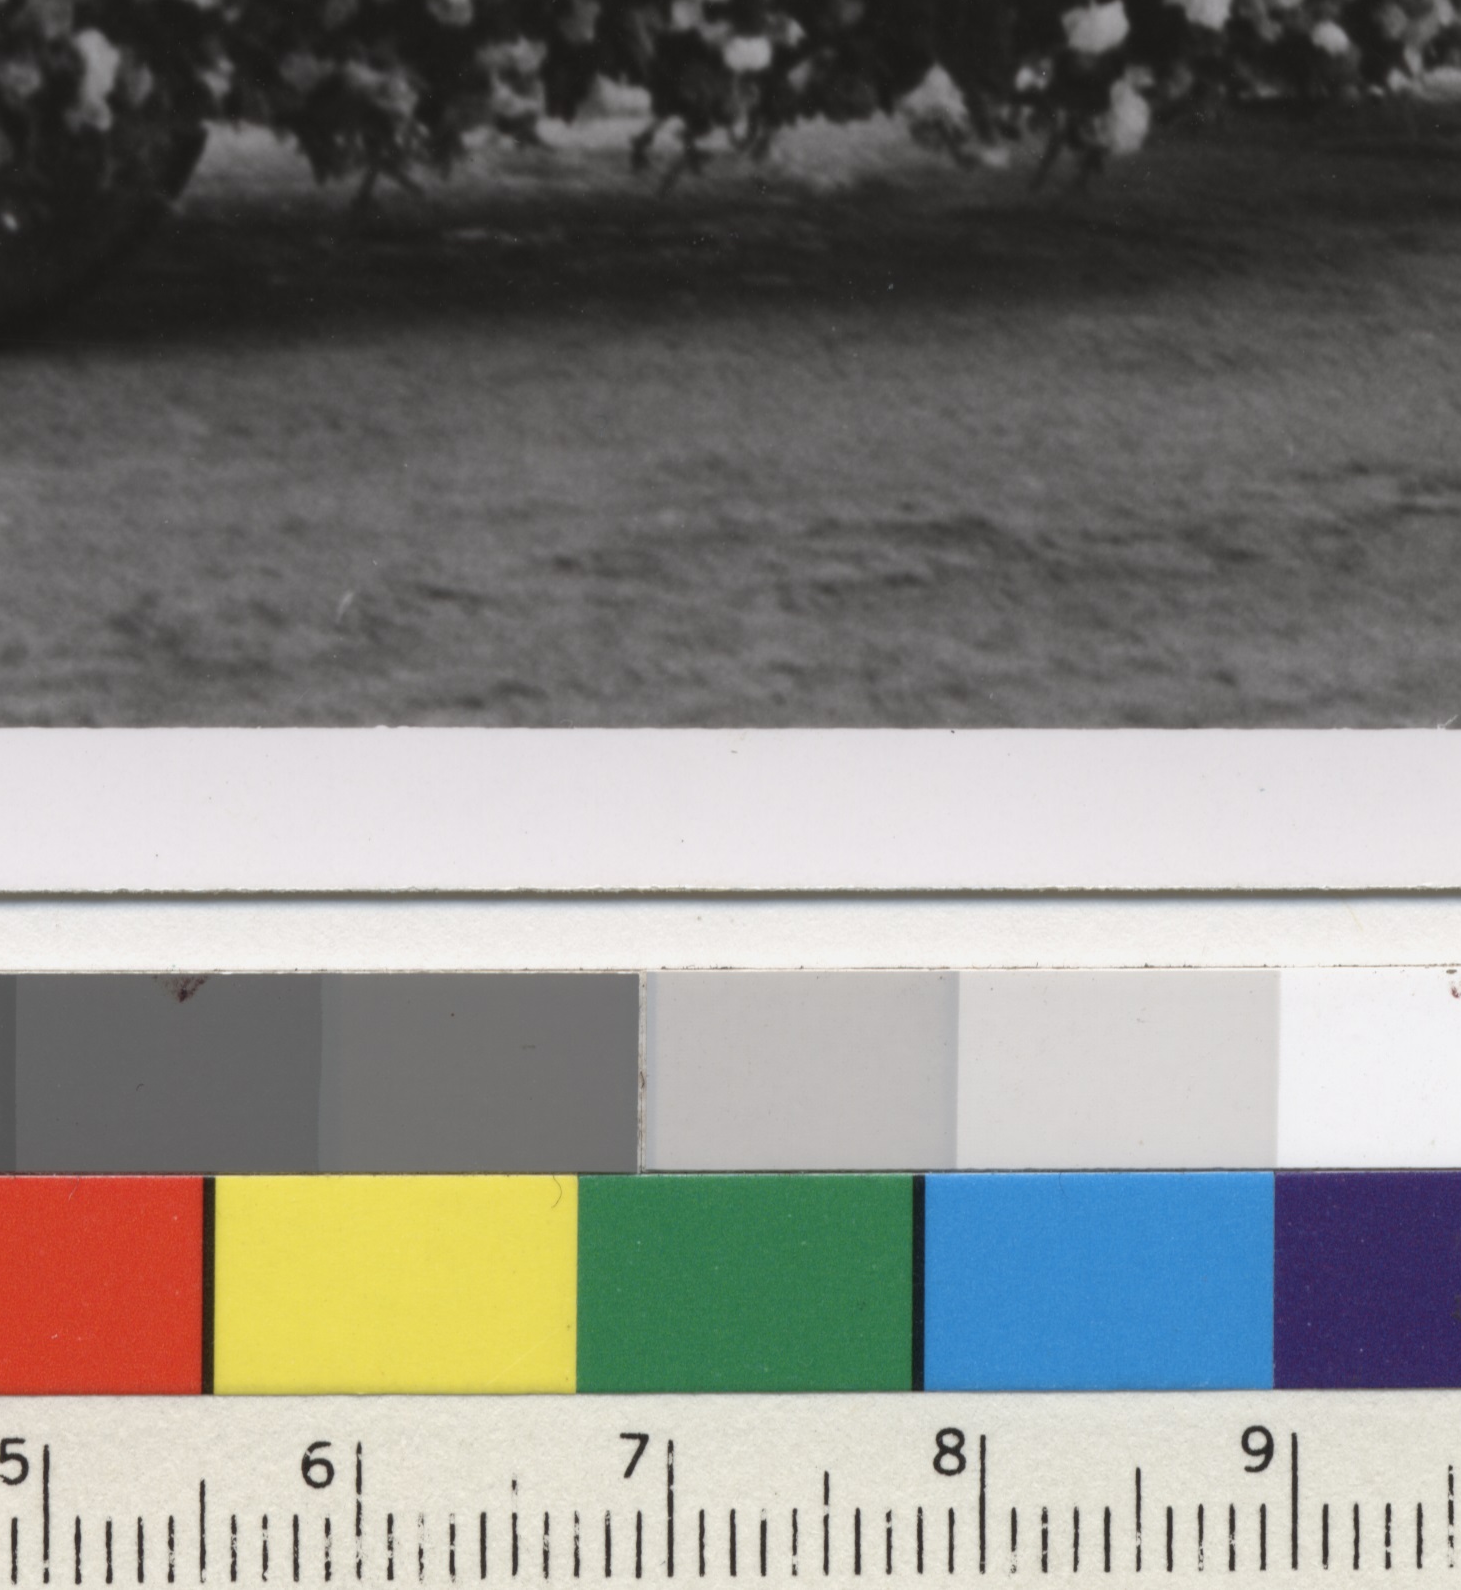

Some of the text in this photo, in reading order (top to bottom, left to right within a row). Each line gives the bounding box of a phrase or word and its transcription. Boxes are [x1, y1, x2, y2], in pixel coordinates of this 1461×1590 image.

[300, 1440, 335, 1490] 6
[619, 1432, 651, 1480] 7
[932, 1426, 967, 1477] 8
[1240, 1425, 1275, 1474] 9
